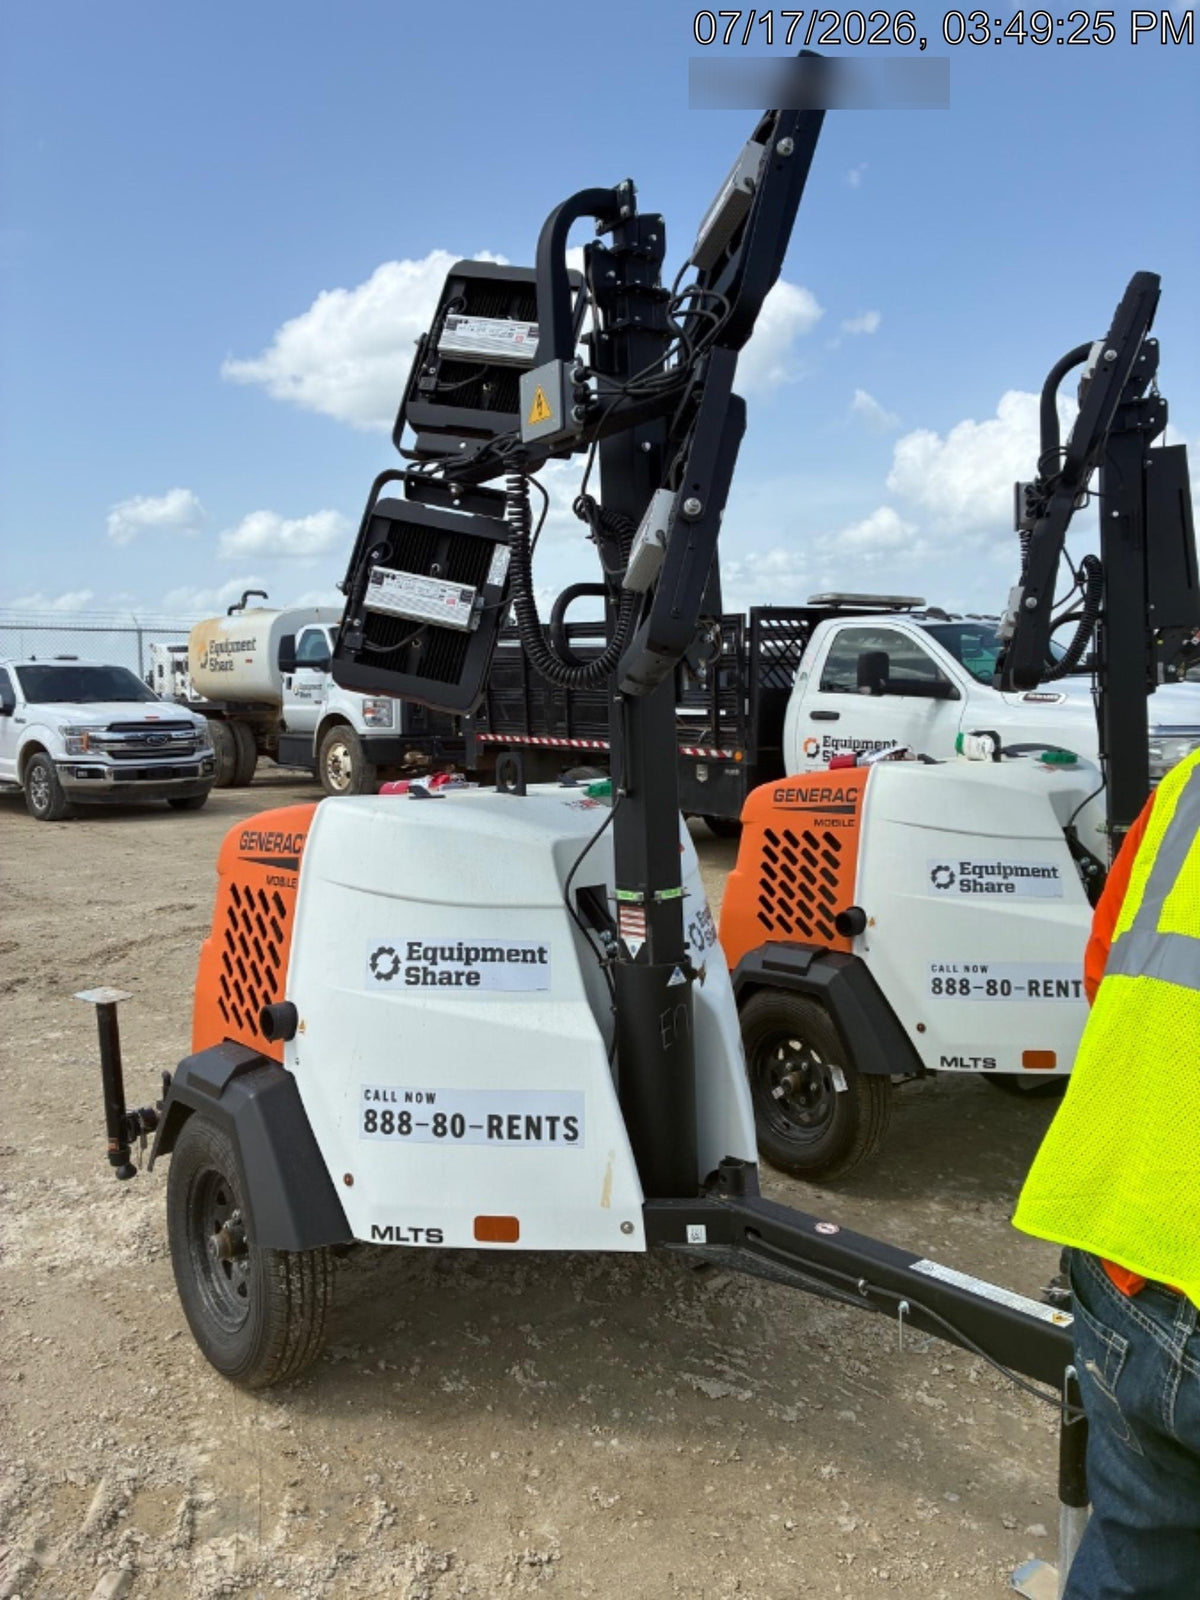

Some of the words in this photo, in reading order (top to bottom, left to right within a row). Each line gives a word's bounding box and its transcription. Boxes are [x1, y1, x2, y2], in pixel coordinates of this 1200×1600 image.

[209, 637, 257, 656] Equipment
[209, 657, 234, 672] Share
[773, 787, 858, 802] GENERAC
[814, 819, 855, 827] MOBILE
[239, 830, 303, 854] GENERAC
[960, 862, 1059, 880] Equipment
[266, 875, 297, 888] MOBILE
[960, 879, 1015, 893] Share
[405, 941, 548, 966] Equipment
[404, 966, 481, 987] Share
[931, 964, 959, 973] CALL
[964, 964, 989, 974] NOW
[931, 977, 1083, 998] 888-80-RENT
[940, 1056, 997, 1069] MLTS
[364, 1089, 398, 1102] CALL
[404, 1090, 437, 1104] NOW
[363, 1108, 579, 1142] 888-80-RENTS
[371, 1224, 444, 1244] MLTS
